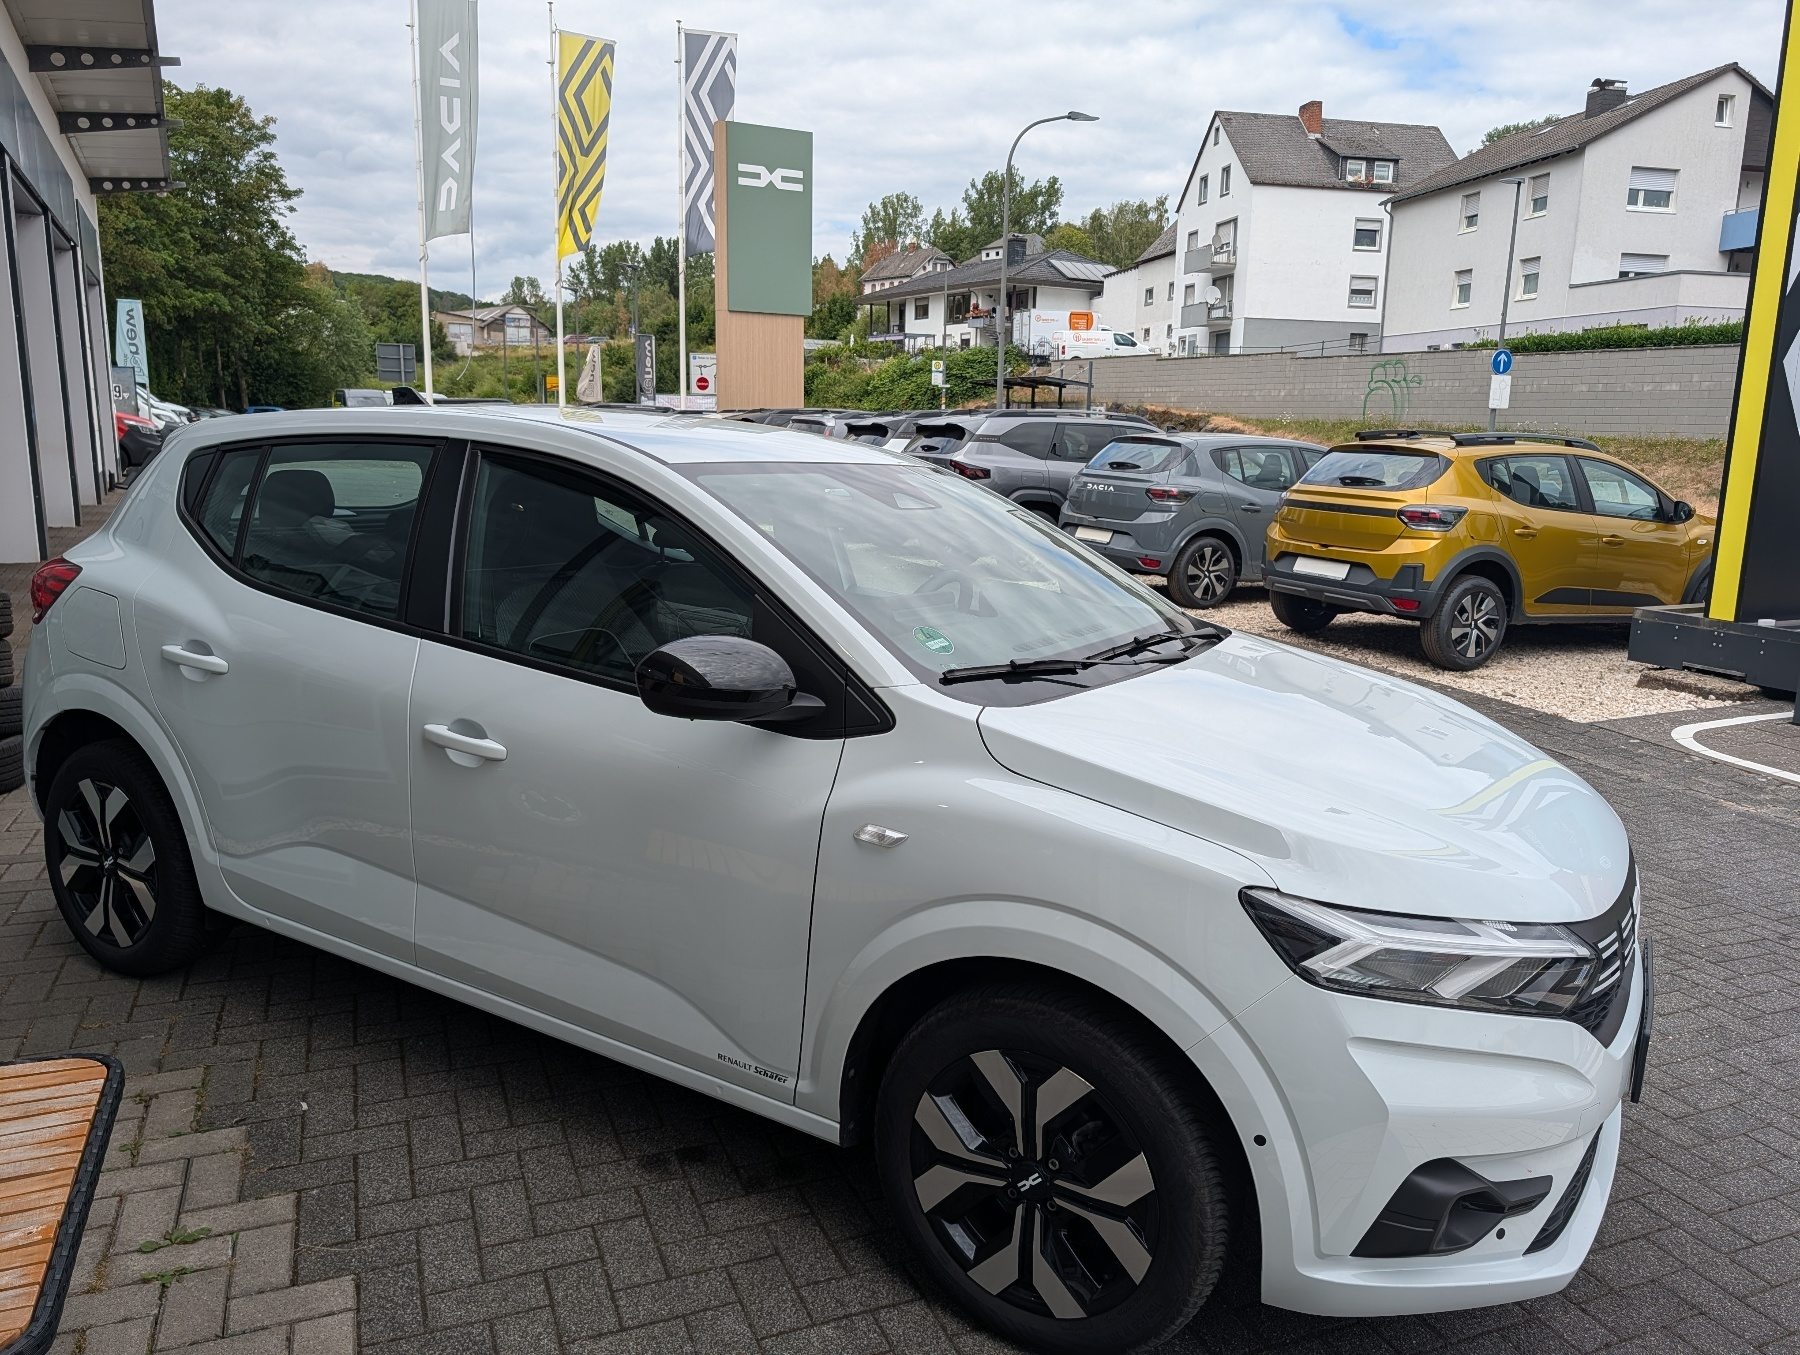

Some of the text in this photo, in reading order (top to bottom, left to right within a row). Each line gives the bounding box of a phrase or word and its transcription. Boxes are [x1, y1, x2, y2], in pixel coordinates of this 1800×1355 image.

[439, 32, 461, 212] DACIA
[1086, 483, 1114, 492] DACIA
[717, 1053, 788, 1084] RENAULT Schäfer
